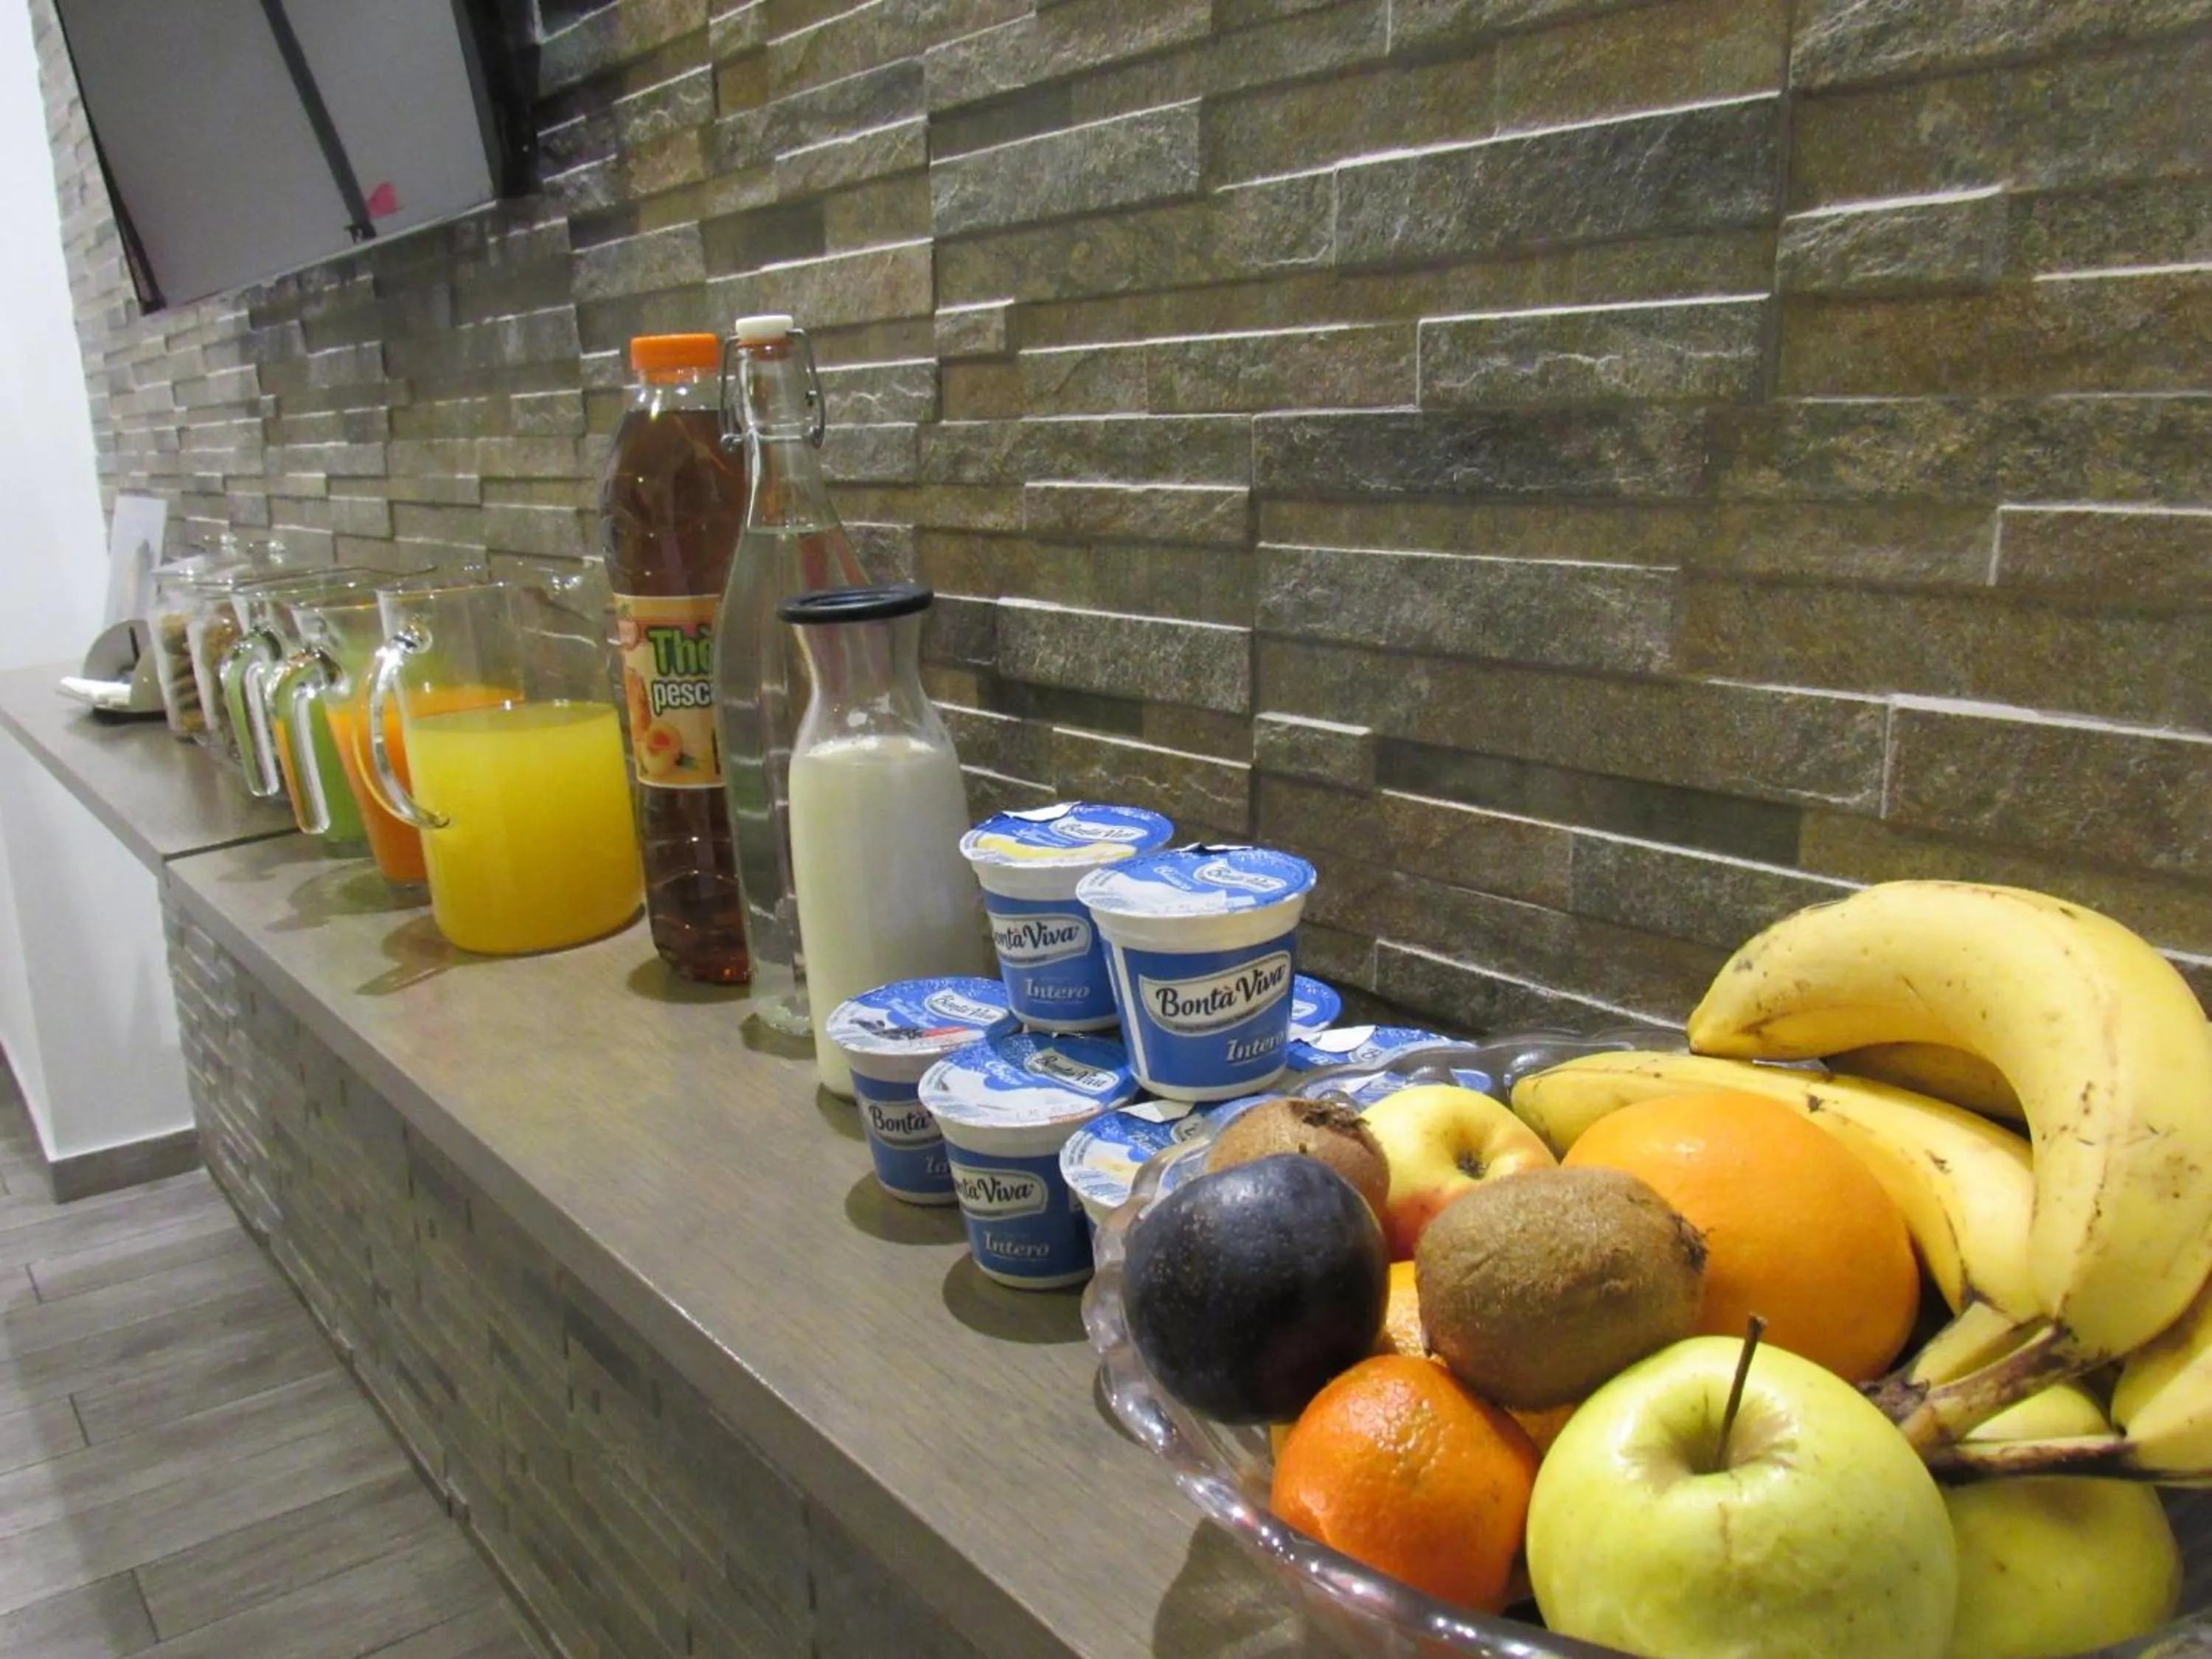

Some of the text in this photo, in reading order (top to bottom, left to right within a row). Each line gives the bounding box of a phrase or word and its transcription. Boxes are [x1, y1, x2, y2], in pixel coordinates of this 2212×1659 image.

[653, 682, 711, 714] pesc
[1023, 921, 1079, 948] Viva
[1025, 978, 1091, 999] Intero
[1155, 964, 1285, 1016] Bontà Viva
[977, 1177, 1033, 1203] Viva
[983, 1231, 1049, 1256] Intero
